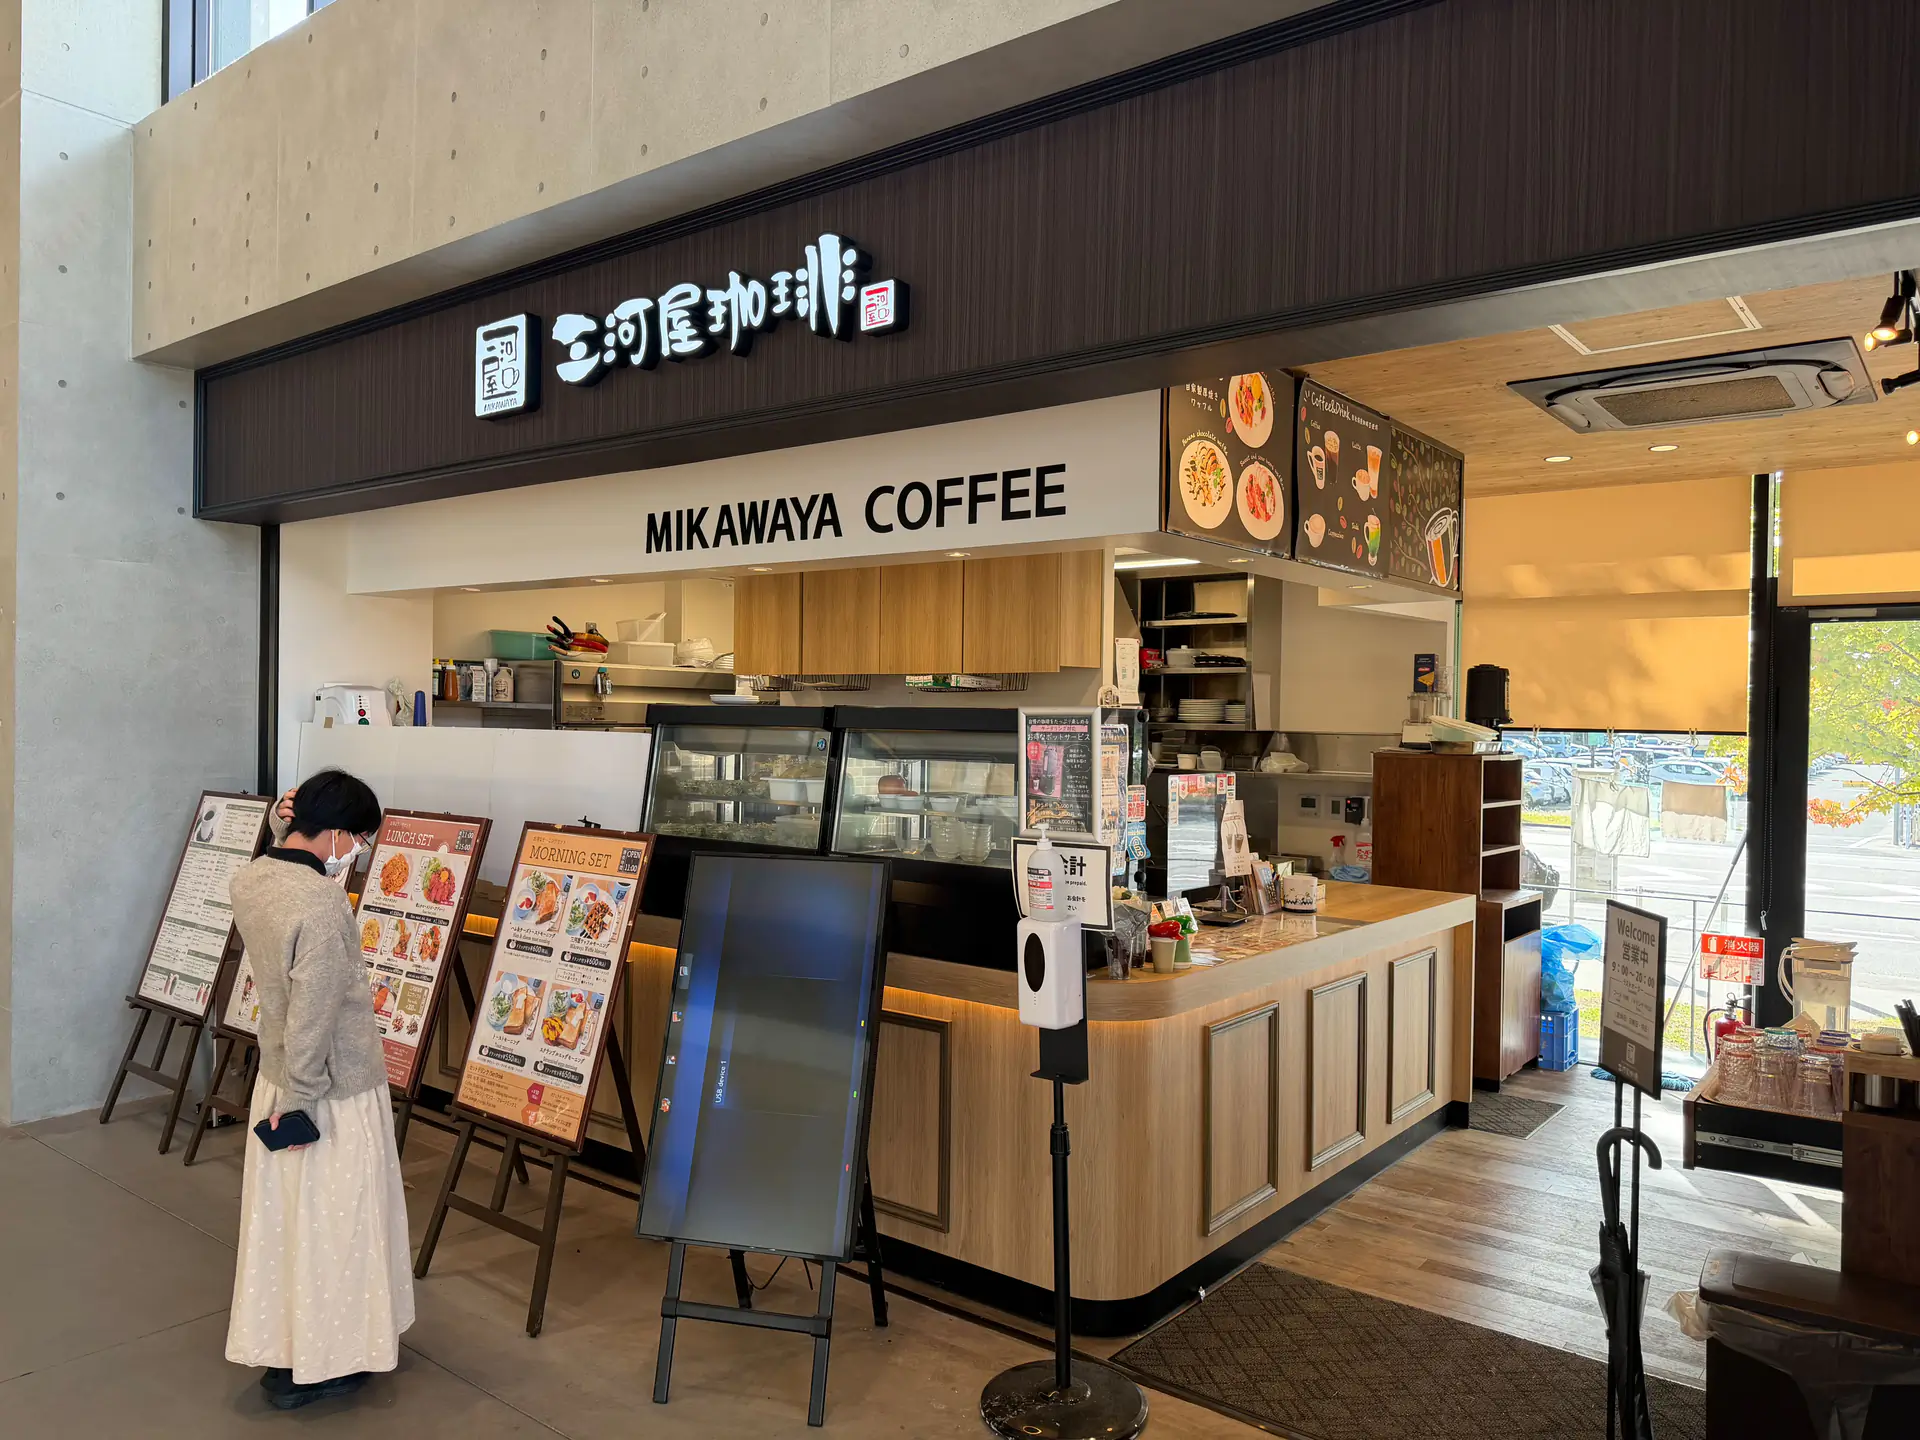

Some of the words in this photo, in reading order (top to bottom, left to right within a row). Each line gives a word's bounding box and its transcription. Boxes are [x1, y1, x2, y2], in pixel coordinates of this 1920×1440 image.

[552, 232, 857, 382] 三河屋珈琲
[1191, 398, 1213, 412] ワッフル
[1196, 429, 1217, 442] chocolate
[645, 492, 843, 554] MIKAWAYA
[864, 463, 1066, 533] COFFEE
[1027, 732, 1091, 742] お得なポットサービス
[386, 829, 416, 845] LUNCH
[416, 833, 434, 847] SET
[461, 831, 474, 839] 11:00
[529, 845, 586, 866] MORNING
[588, 852, 612, 869] SET
[626, 850, 642, 859] OPEN
[624, 864, 638, 872] 11:00
[1617, 917, 1656, 948] Welcome
[1724, 939, 1760, 953] 消火器
[1622, 940, 1649, 968] 営業中
[718, 1066, 726, 1087] device
[715, 1088, 723, 1103] USB
